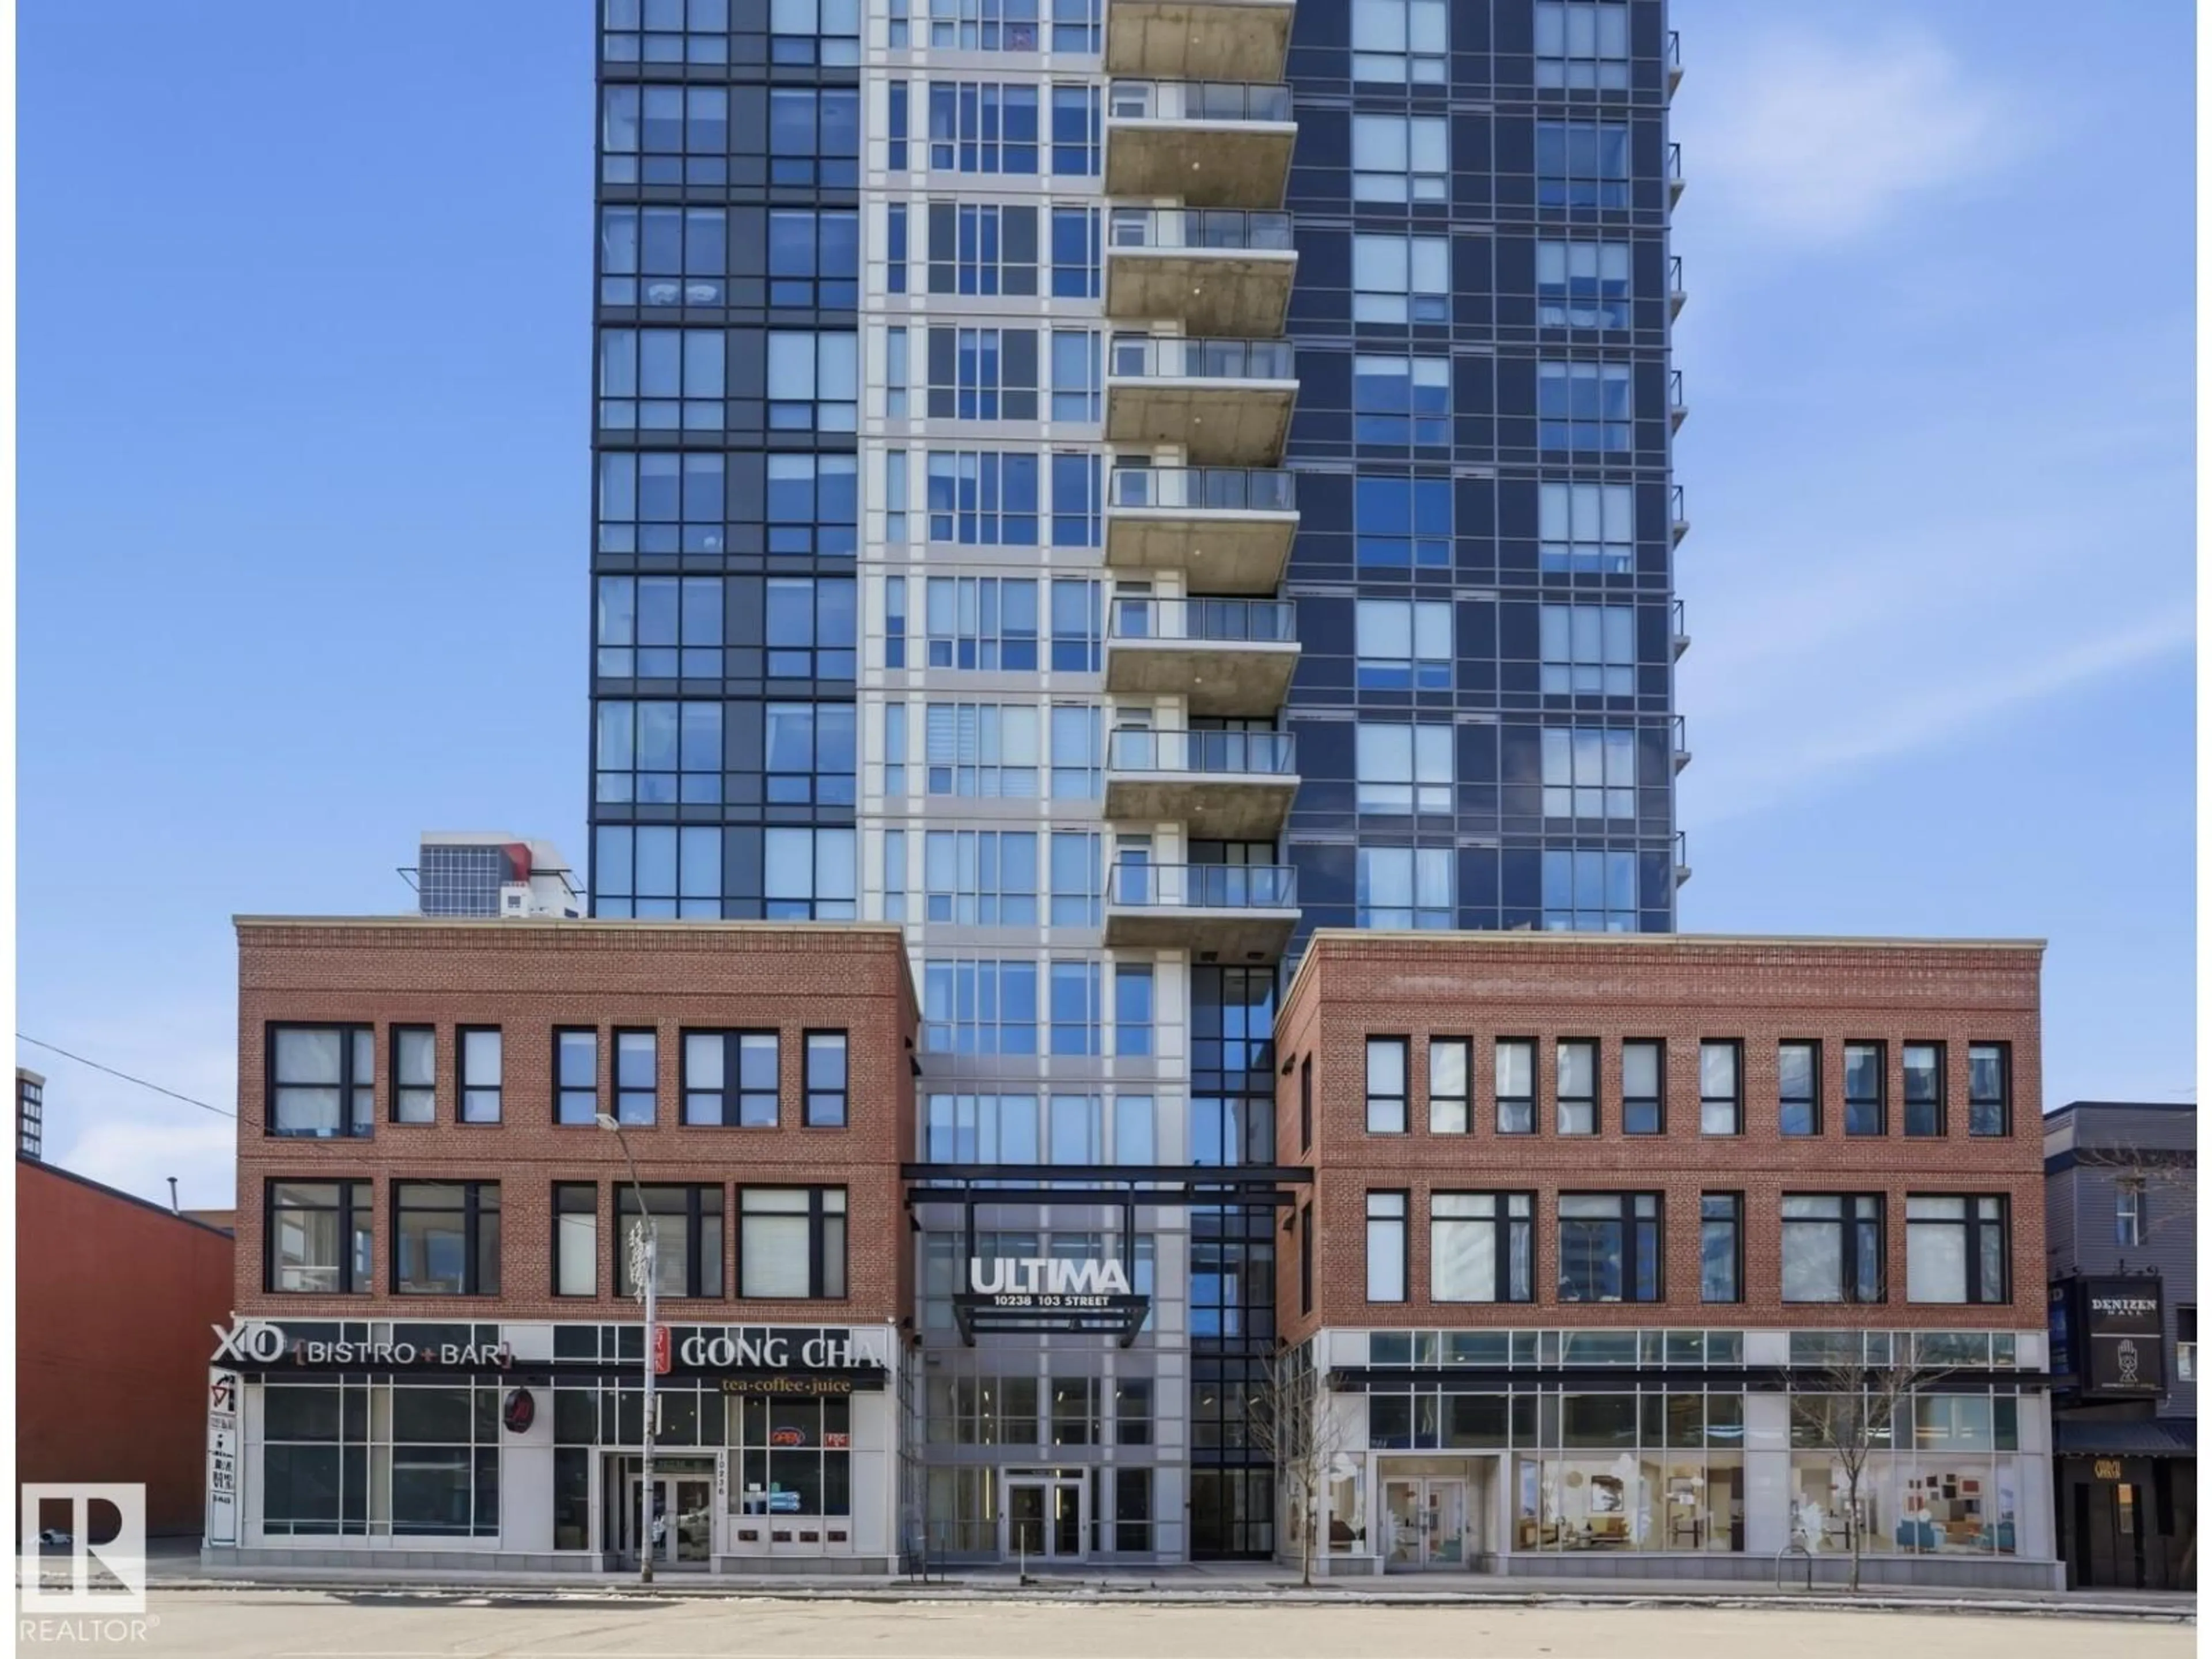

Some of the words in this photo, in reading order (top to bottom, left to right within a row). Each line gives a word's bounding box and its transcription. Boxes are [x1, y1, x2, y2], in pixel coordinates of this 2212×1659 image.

[971, 1257, 1131, 1294] ULTIMA
[995, 1296, 1032, 1306] 10238
[1039, 1296, 1060, 1306] 103
[1066, 1296, 1109, 1306] STREET
[2092, 1299, 2157, 1310] DENIZEN
[210, 1324, 285, 1362] XO
[681, 1336, 789, 1368] GONG
[802, 1338, 880, 1368] CHA
